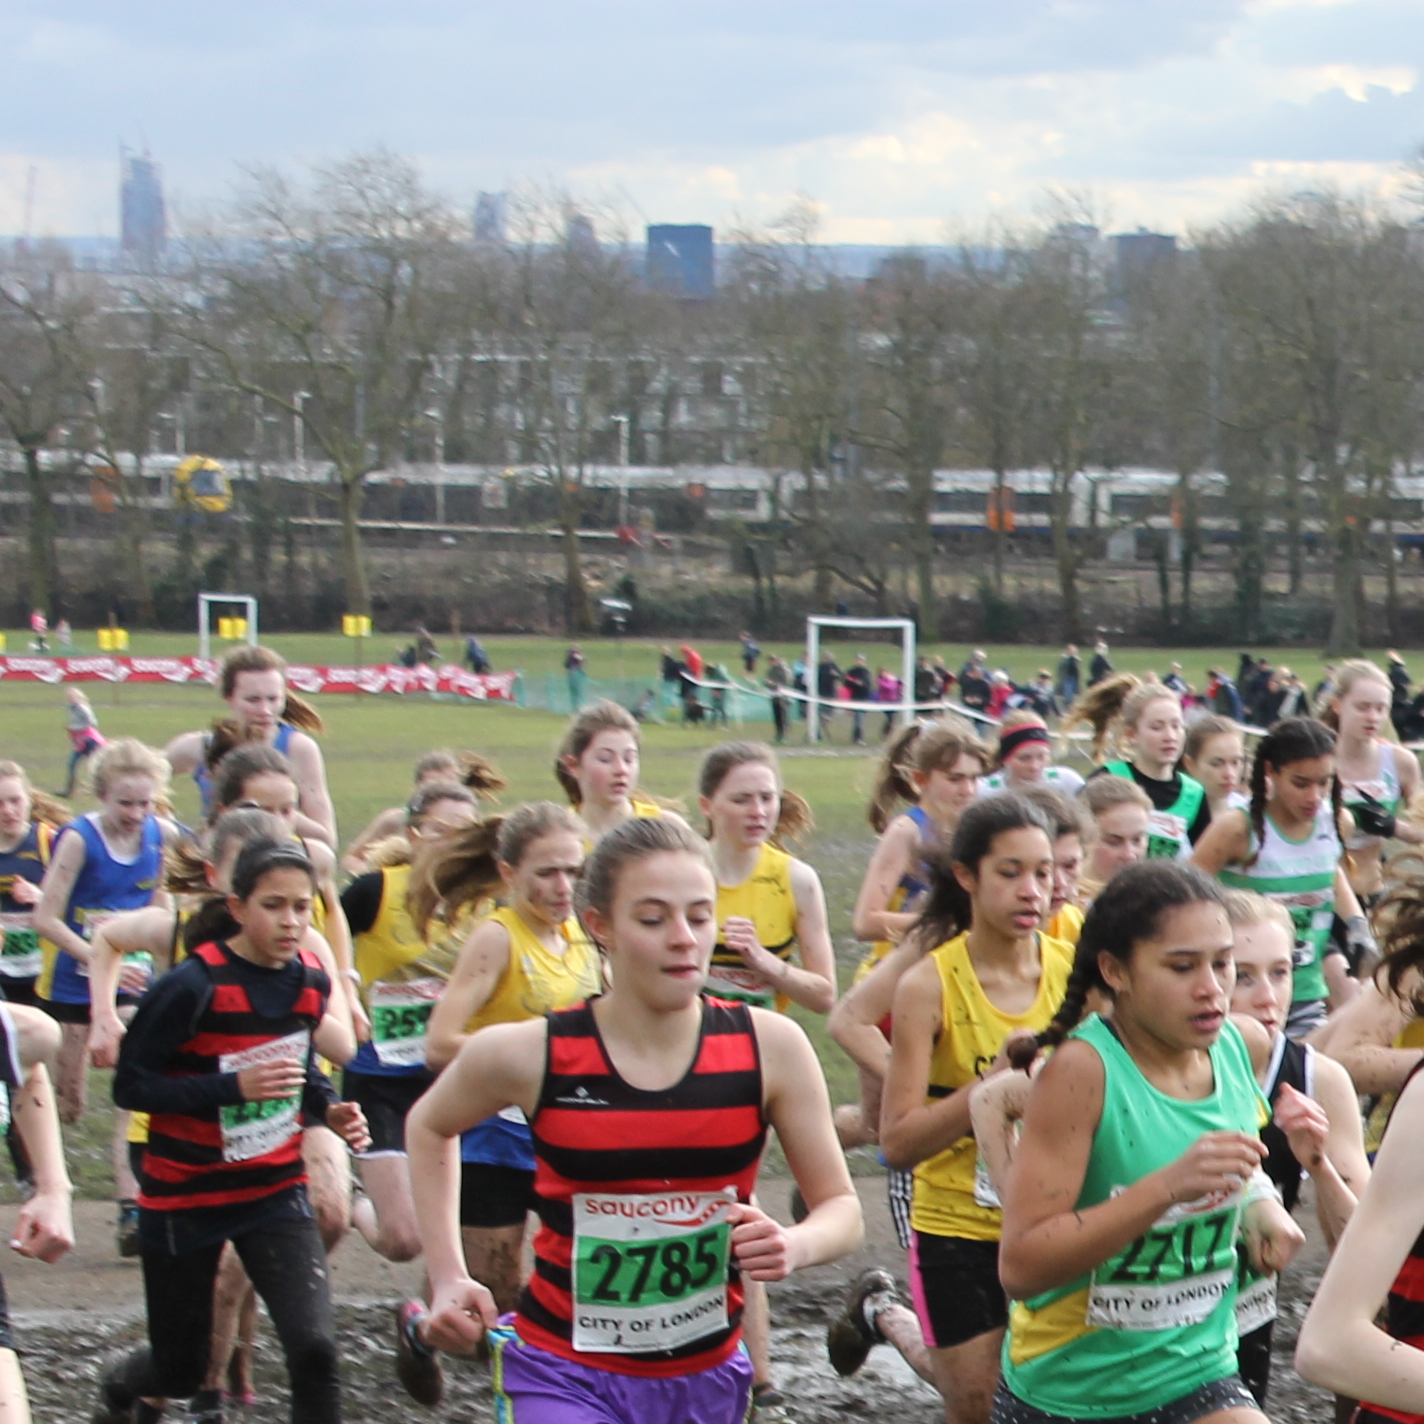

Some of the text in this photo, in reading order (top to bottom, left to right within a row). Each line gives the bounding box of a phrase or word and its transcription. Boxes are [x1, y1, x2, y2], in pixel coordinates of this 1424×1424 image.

[586, 1194, 700, 1218] saucony
[1110, 1215, 1229, 1281] 2717
[590, 1231, 720, 1303] 2785
[579, 1296, 726, 1332] CITY OF LONDON
[1092, 1281, 1231, 1312] CITY OF LONDON
